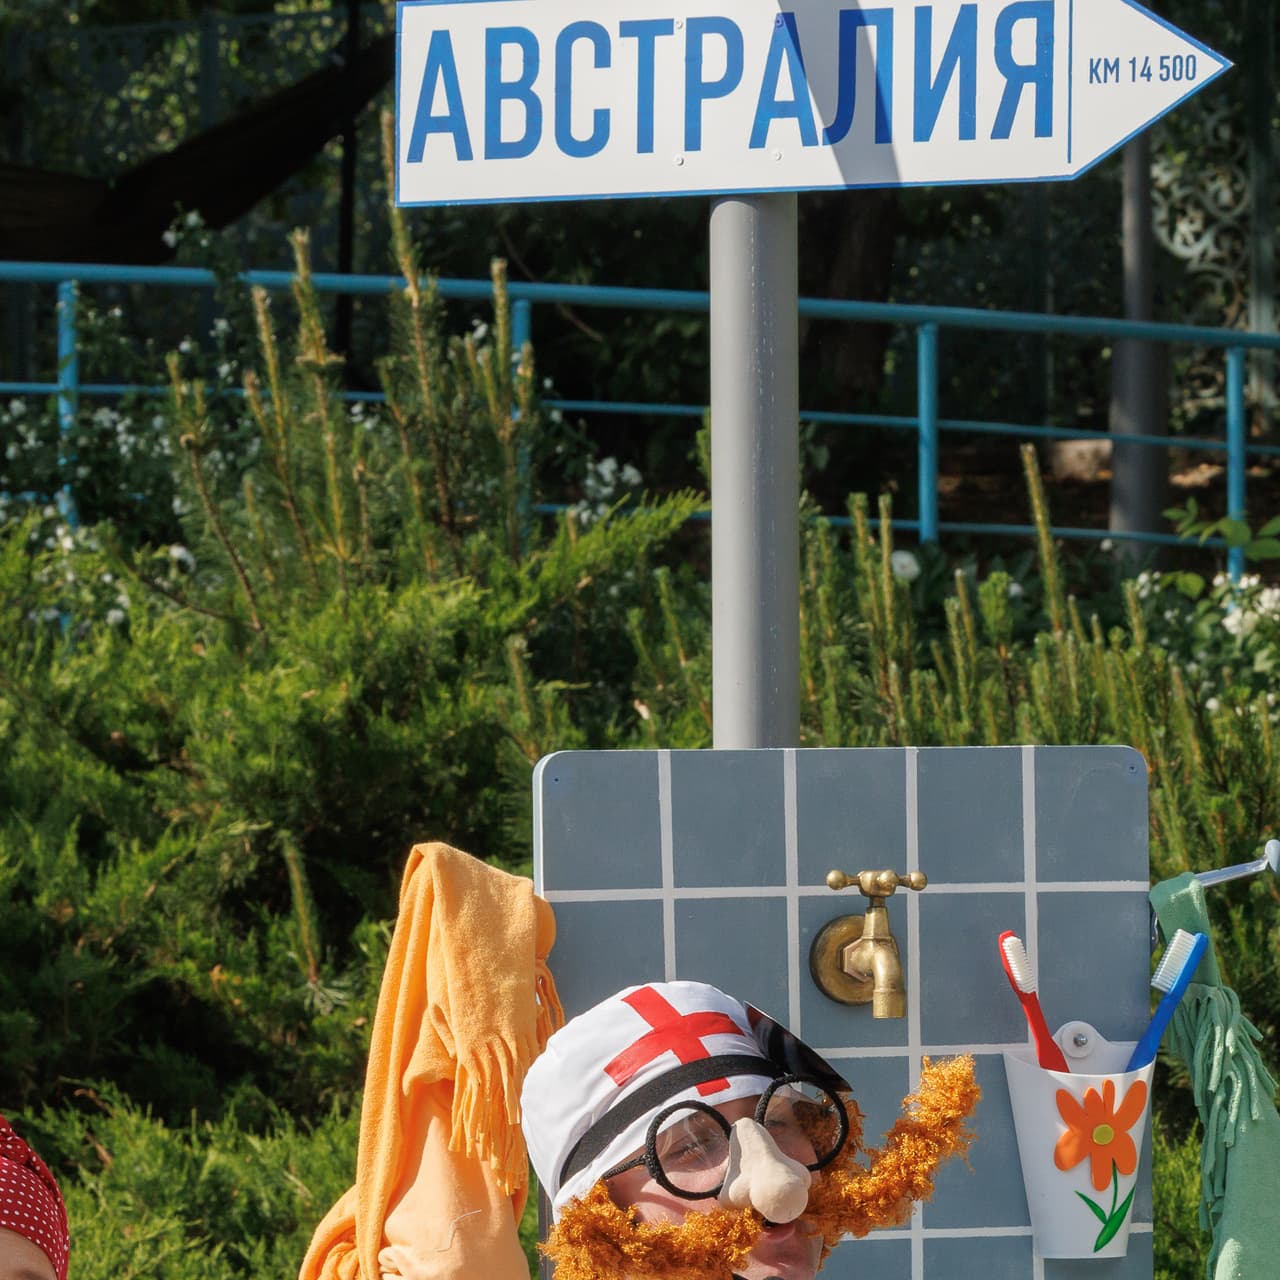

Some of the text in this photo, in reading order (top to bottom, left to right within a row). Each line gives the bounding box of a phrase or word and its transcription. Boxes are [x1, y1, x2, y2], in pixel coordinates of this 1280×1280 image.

[406, 1, 1055, 163] АВСТРАЛИЯ
[1089, 54, 1197, 84] КМ 14 500
